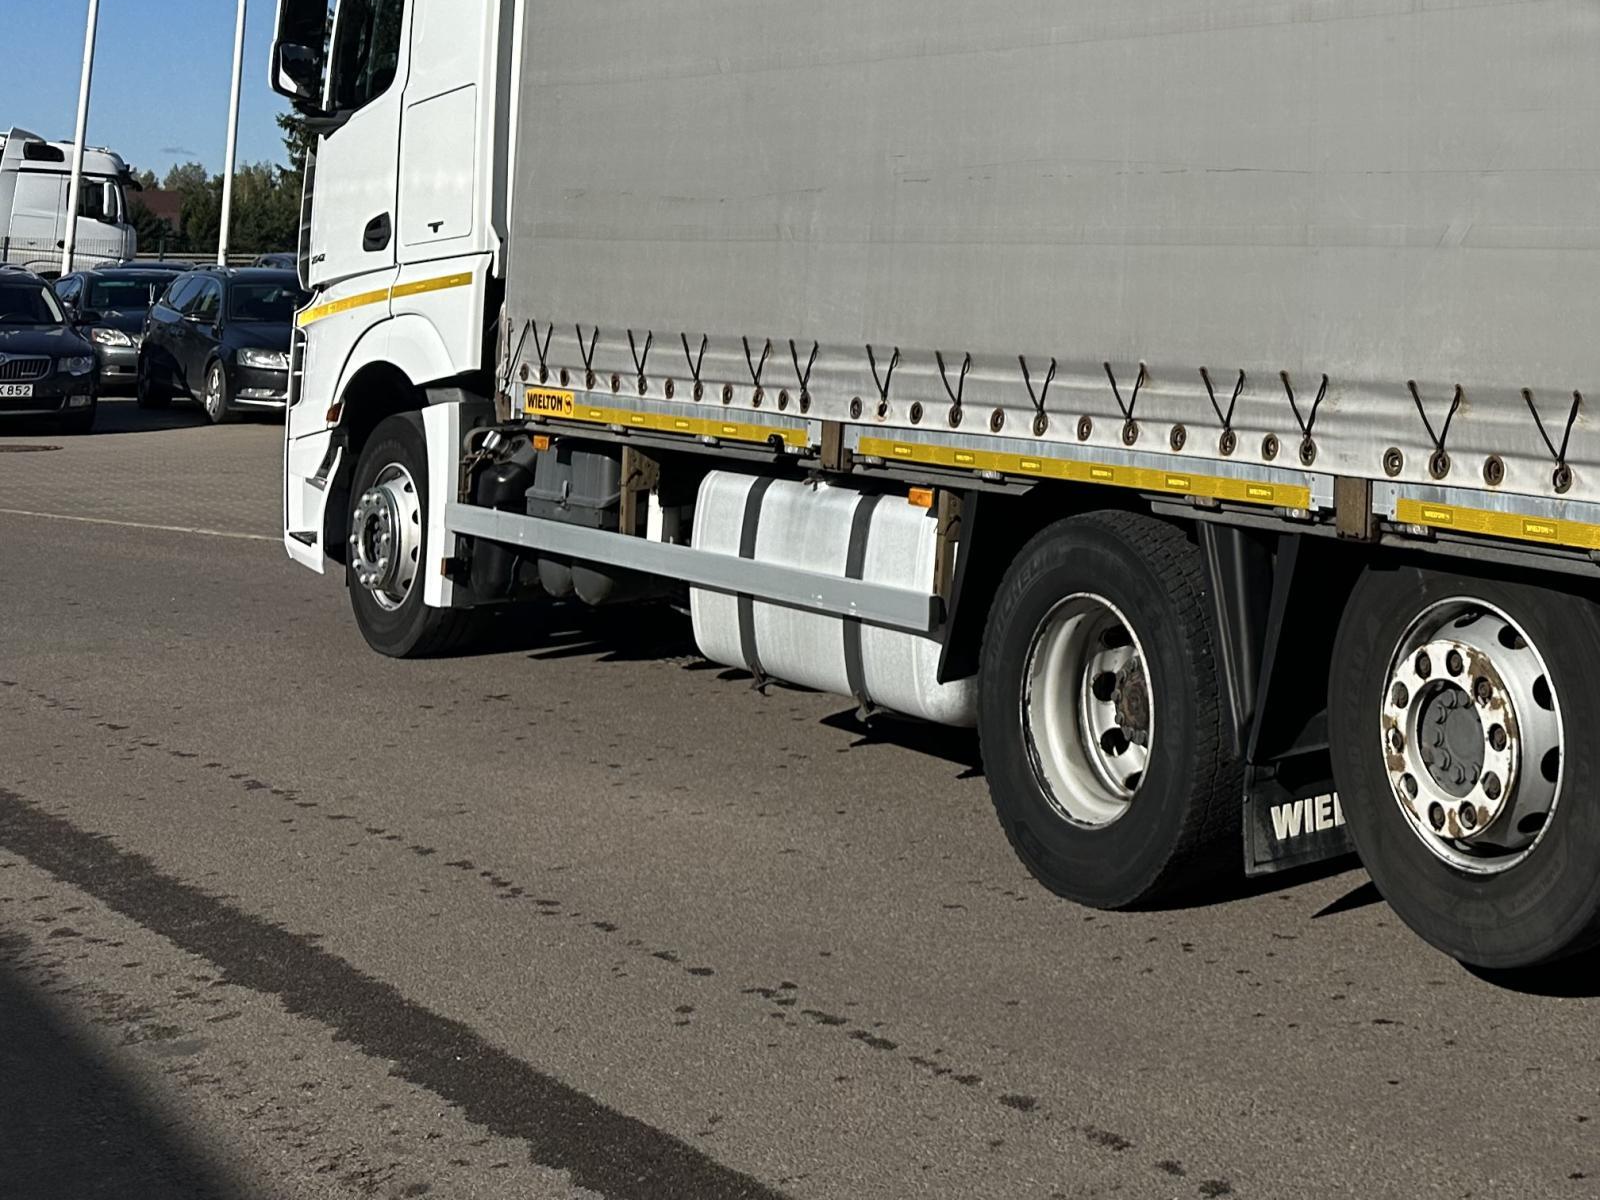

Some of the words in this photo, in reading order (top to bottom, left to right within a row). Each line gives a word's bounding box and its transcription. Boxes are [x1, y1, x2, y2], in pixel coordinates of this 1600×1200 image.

[7, 385, 31, 396] 852
[527, 392, 564, 412] WIELTON
[1270, 791, 1346, 841] WIEL
